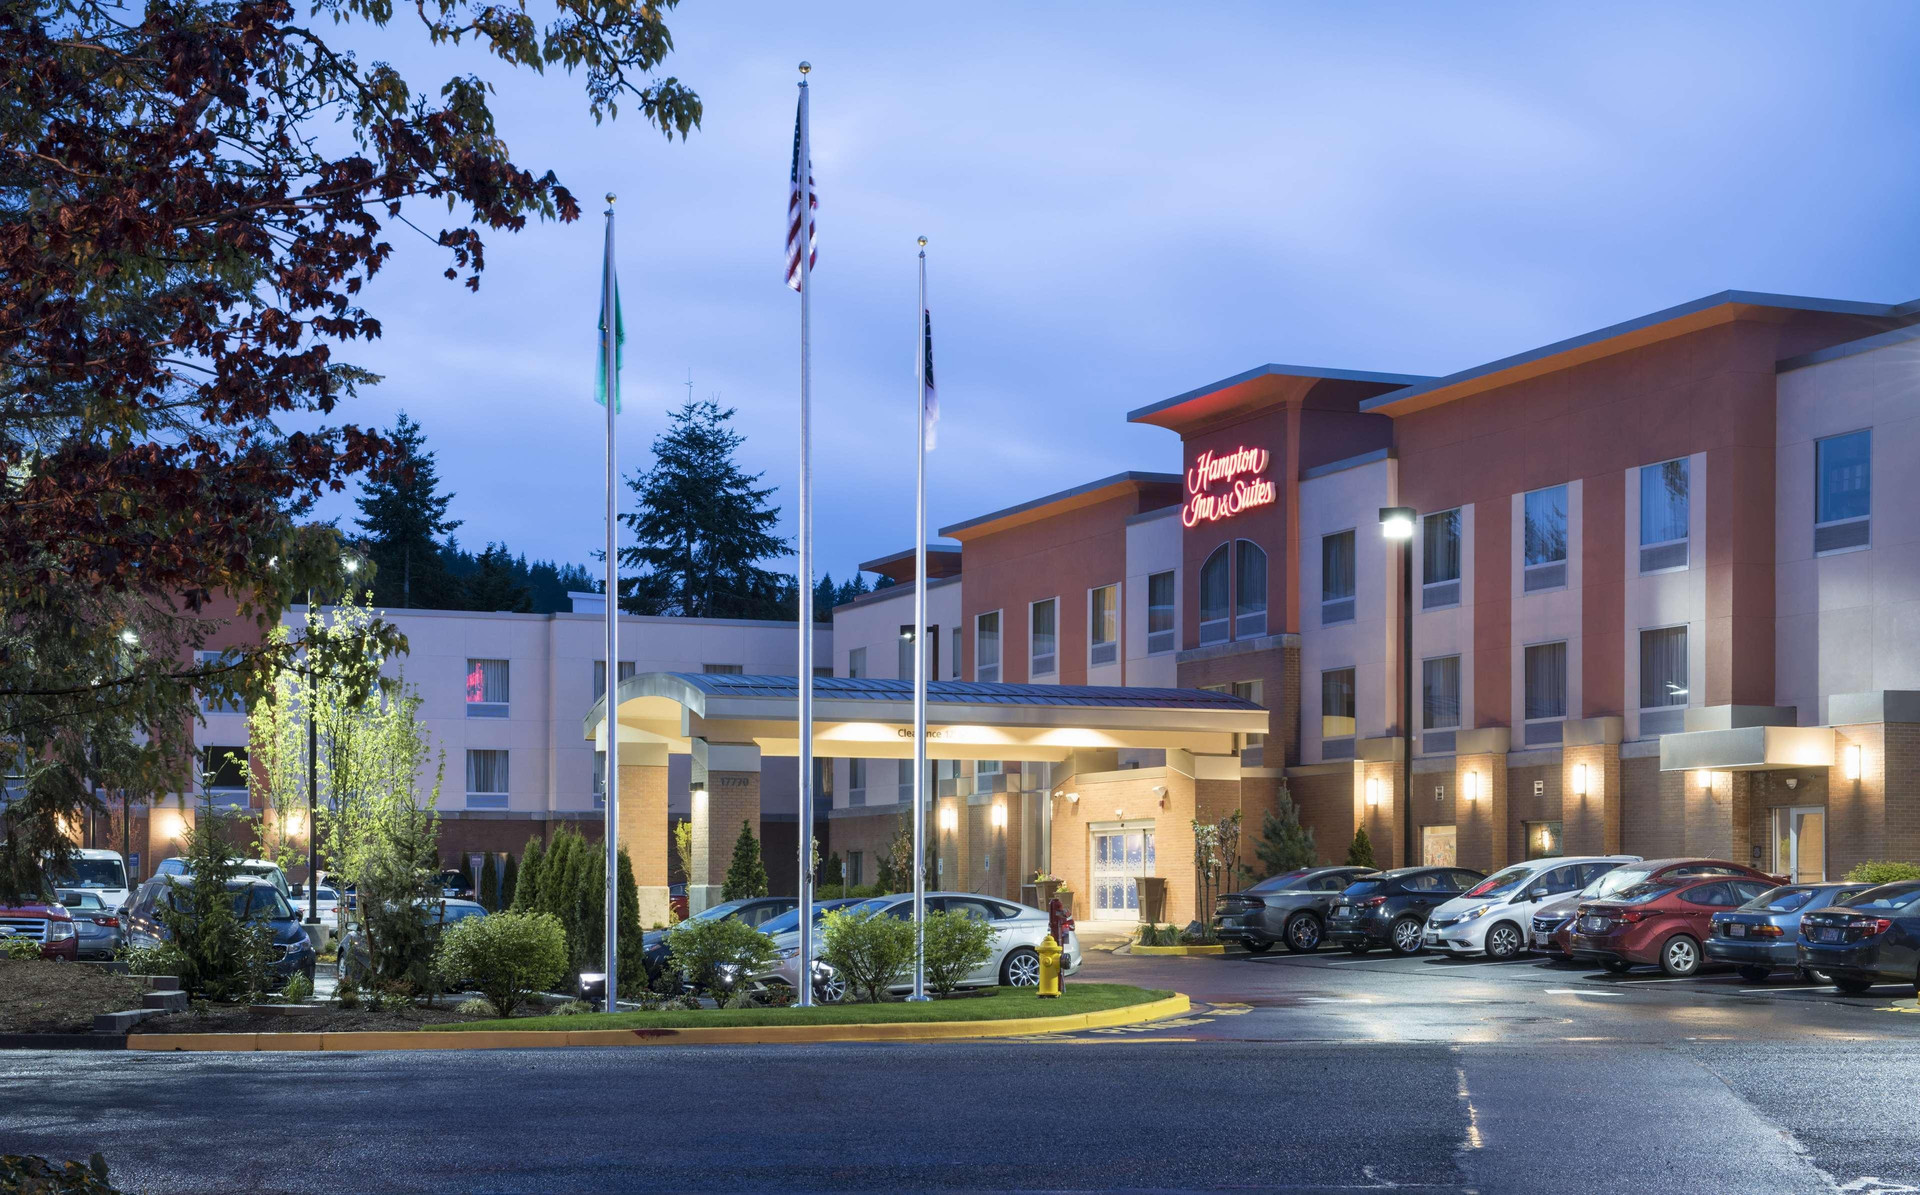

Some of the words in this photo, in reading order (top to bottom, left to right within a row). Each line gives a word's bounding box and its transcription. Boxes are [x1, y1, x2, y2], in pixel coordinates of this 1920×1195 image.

[1188, 446, 1266, 494] Hampton
[1183, 493, 1221, 527] Inn
[1220, 494, 1231, 516] &
[1229, 478, 1273, 513] Suites
[897, 728, 941, 738] Cleance
